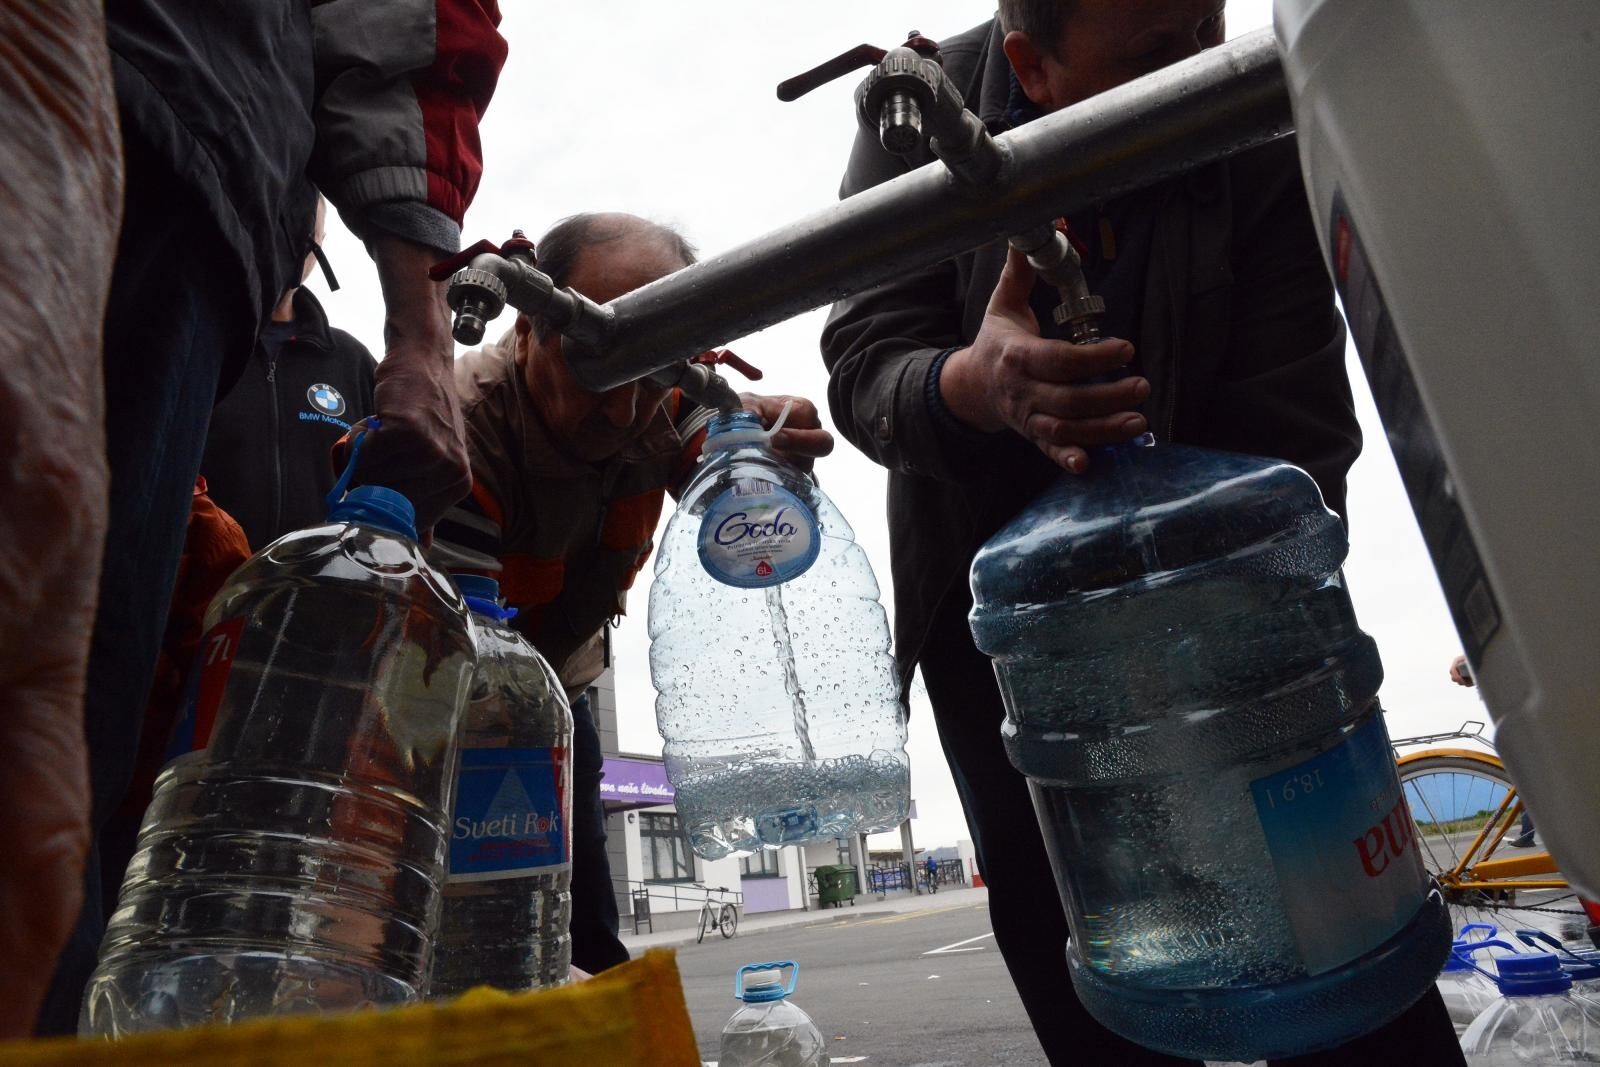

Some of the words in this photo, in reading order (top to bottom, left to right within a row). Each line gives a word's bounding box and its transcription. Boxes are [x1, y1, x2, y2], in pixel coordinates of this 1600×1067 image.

[299, 411, 321, 421] BMW
[714, 507, 798, 546] Goda
[1282, 768, 1325, 801] 18,9
[453, 813, 517, 840] Sveti
